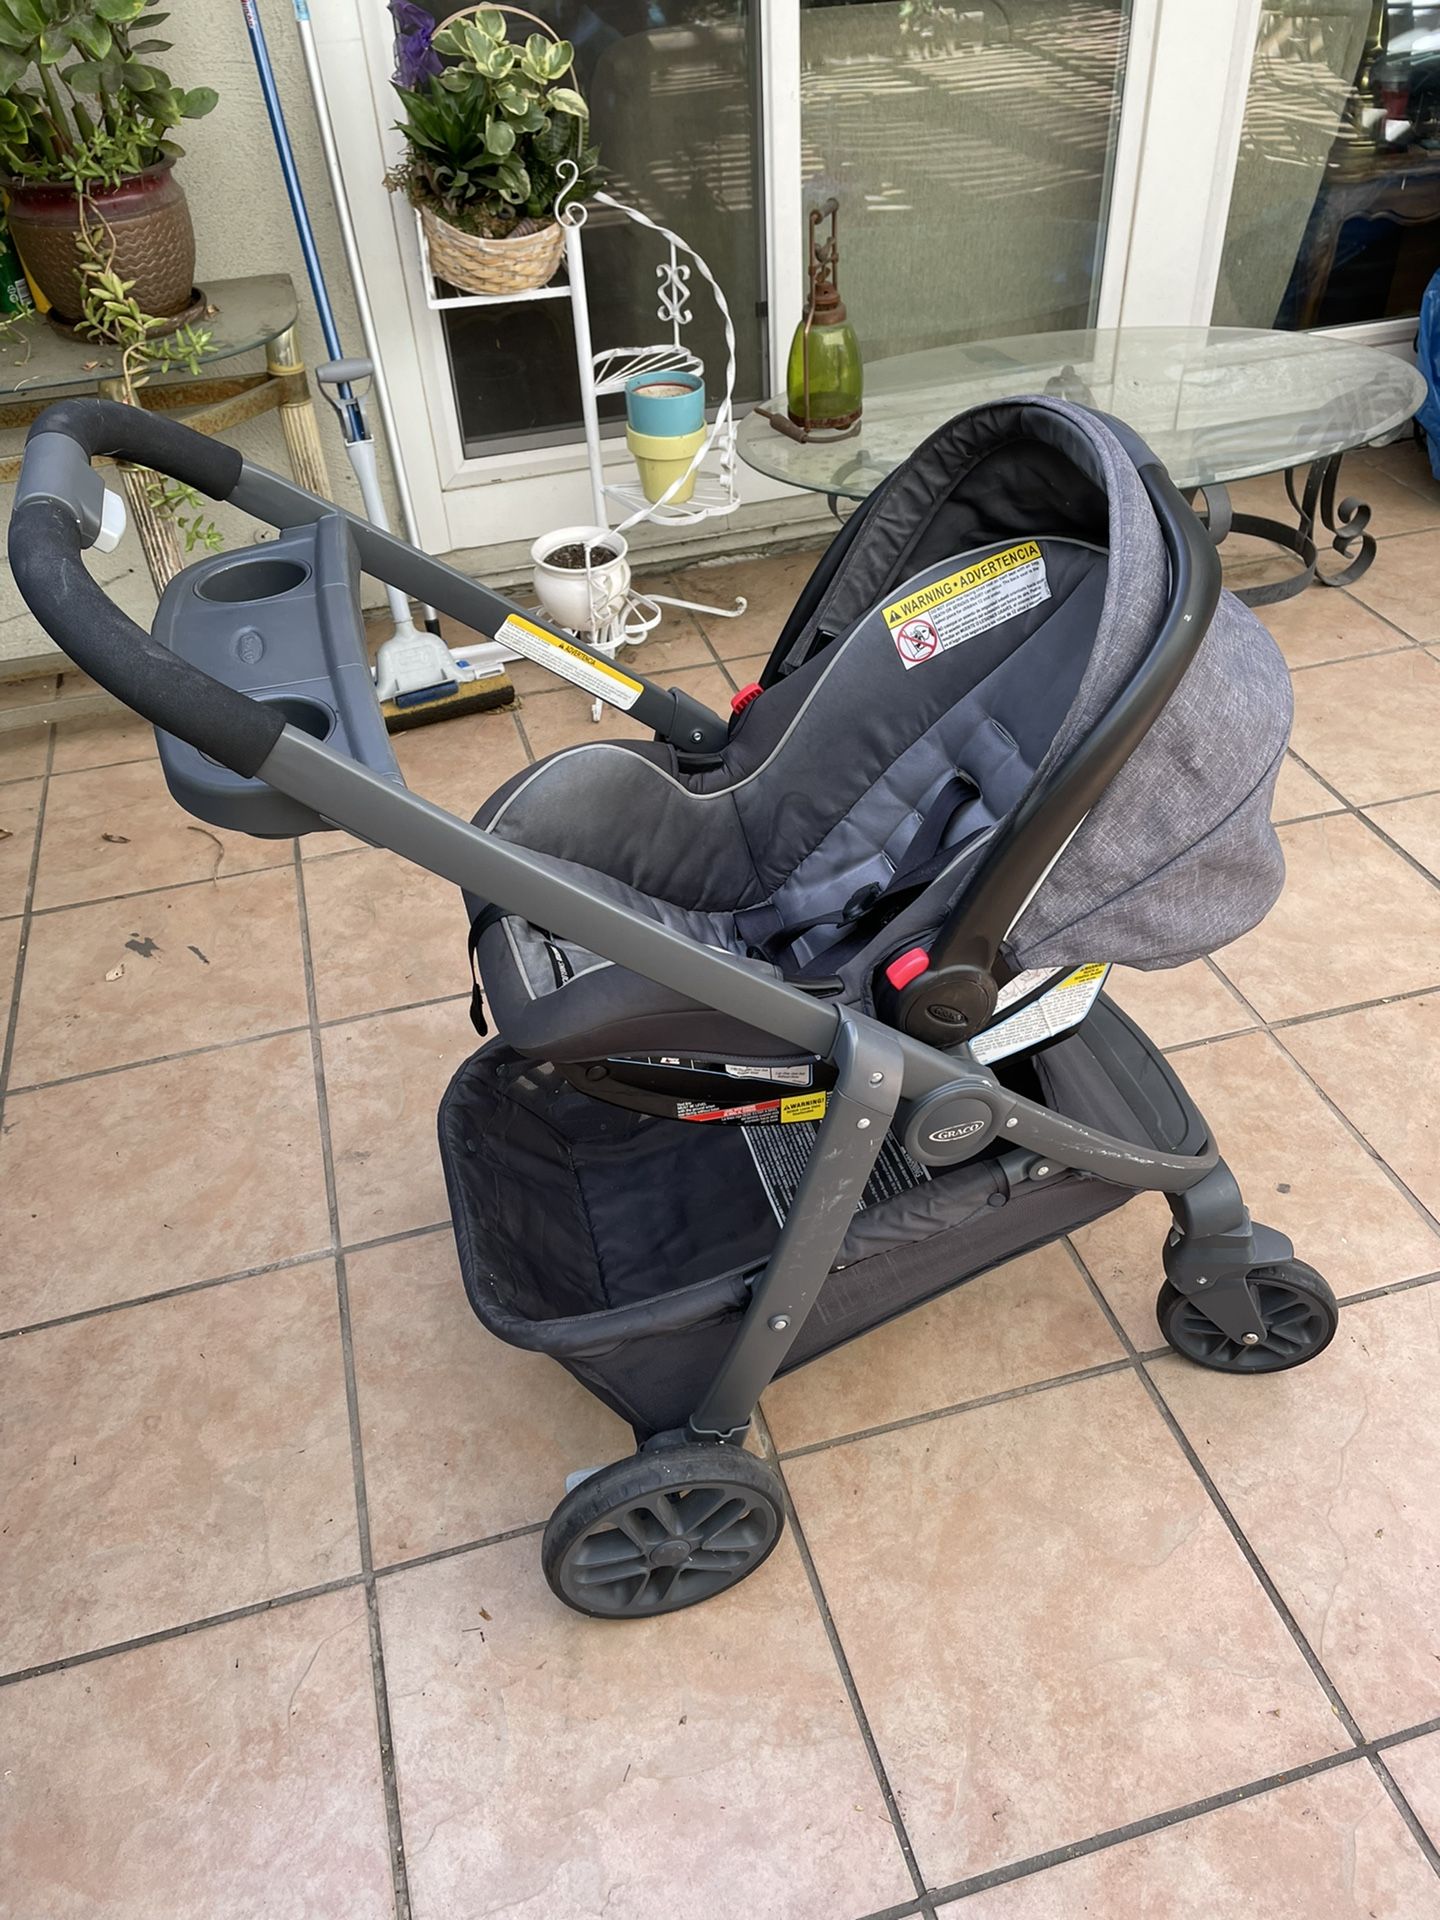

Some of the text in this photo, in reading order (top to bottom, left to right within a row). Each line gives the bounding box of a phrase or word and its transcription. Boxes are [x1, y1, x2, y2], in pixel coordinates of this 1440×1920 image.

[900, 582, 953, 616] WARNING
[959, 545, 1039, 588] ADVERTENCIA
[564, 645, 597, 666] ADVERTENCIA
[936, 1122, 980, 1140] GRACO
